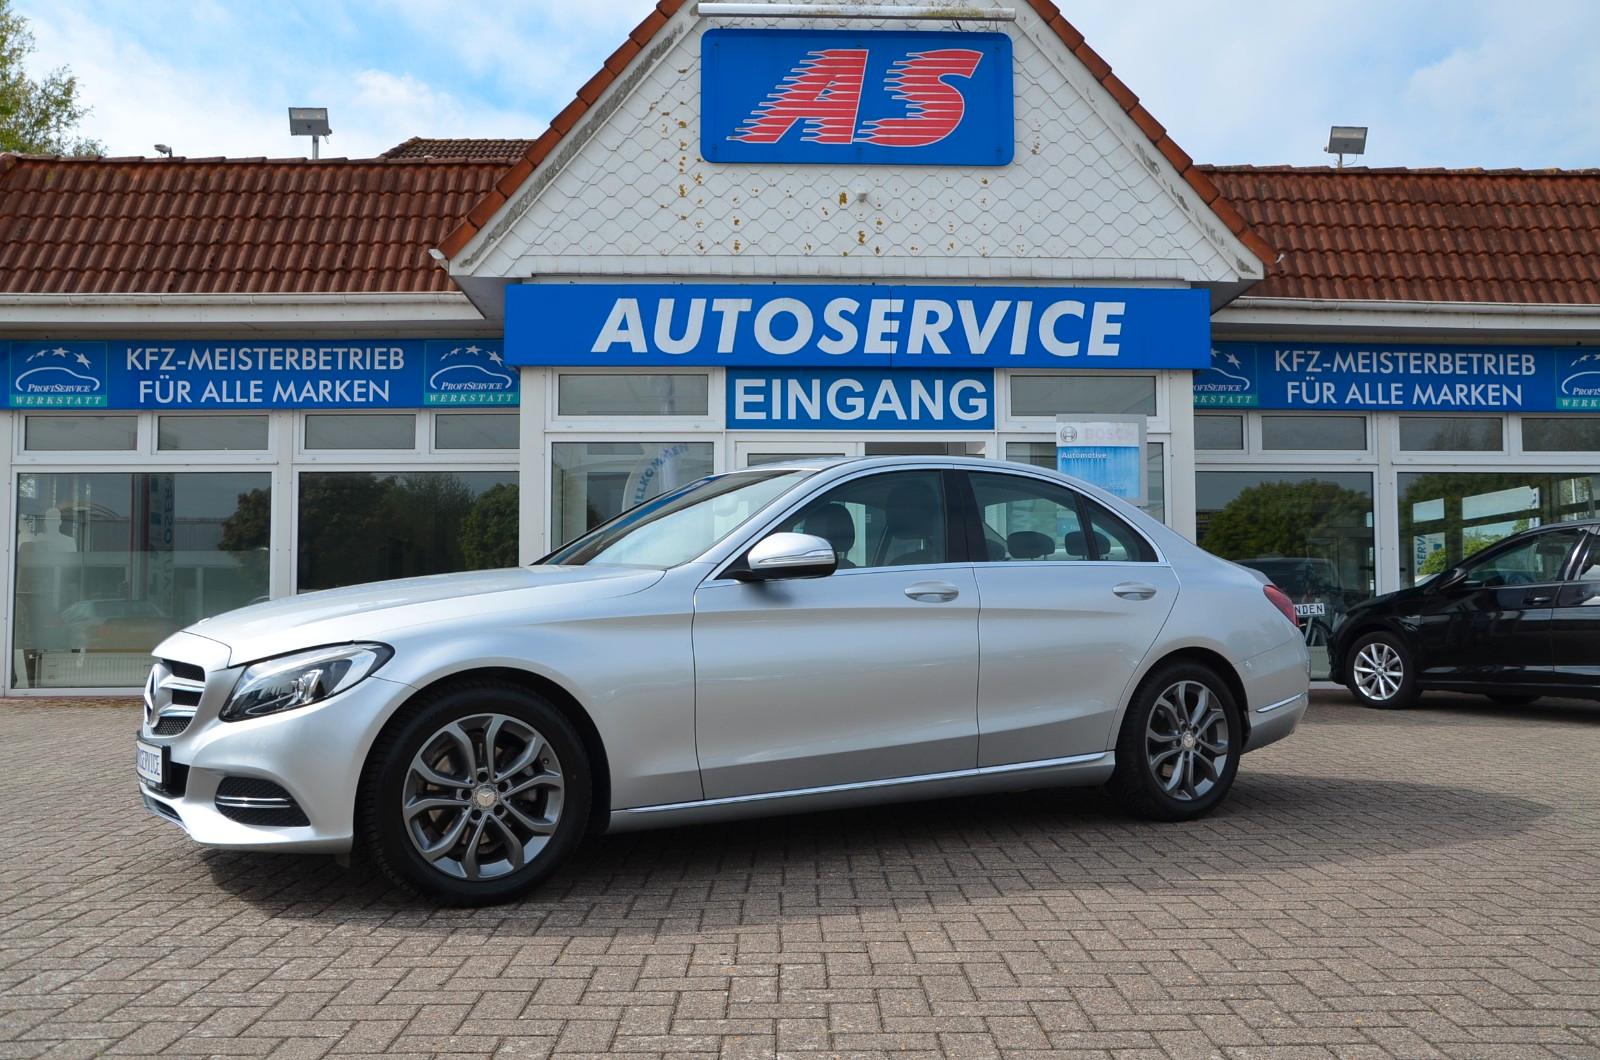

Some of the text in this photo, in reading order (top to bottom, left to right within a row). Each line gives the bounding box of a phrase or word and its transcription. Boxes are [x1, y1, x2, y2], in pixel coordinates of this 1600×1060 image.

[725, 48, 984, 148] AS
[590, 297, 1126, 357] AUTOSERVICE
[126, 347, 405, 371] KFZ-MEISTERBETRIEB
[1274, 350, 1536, 376] KFZ-MEISTERBETRIEB
[15, 395, 102, 405] WERKSTATT
[138, 375, 390, 403] FÜR ALLE MARKEN
[429, 393, 514, 403] WERKSTATT
[735, 378, 988, 422] EINGANG
[1286, 376, 1523, 407] FÜR ALLE MARKEN
[1061, 451, 1108, 459] Automotive
